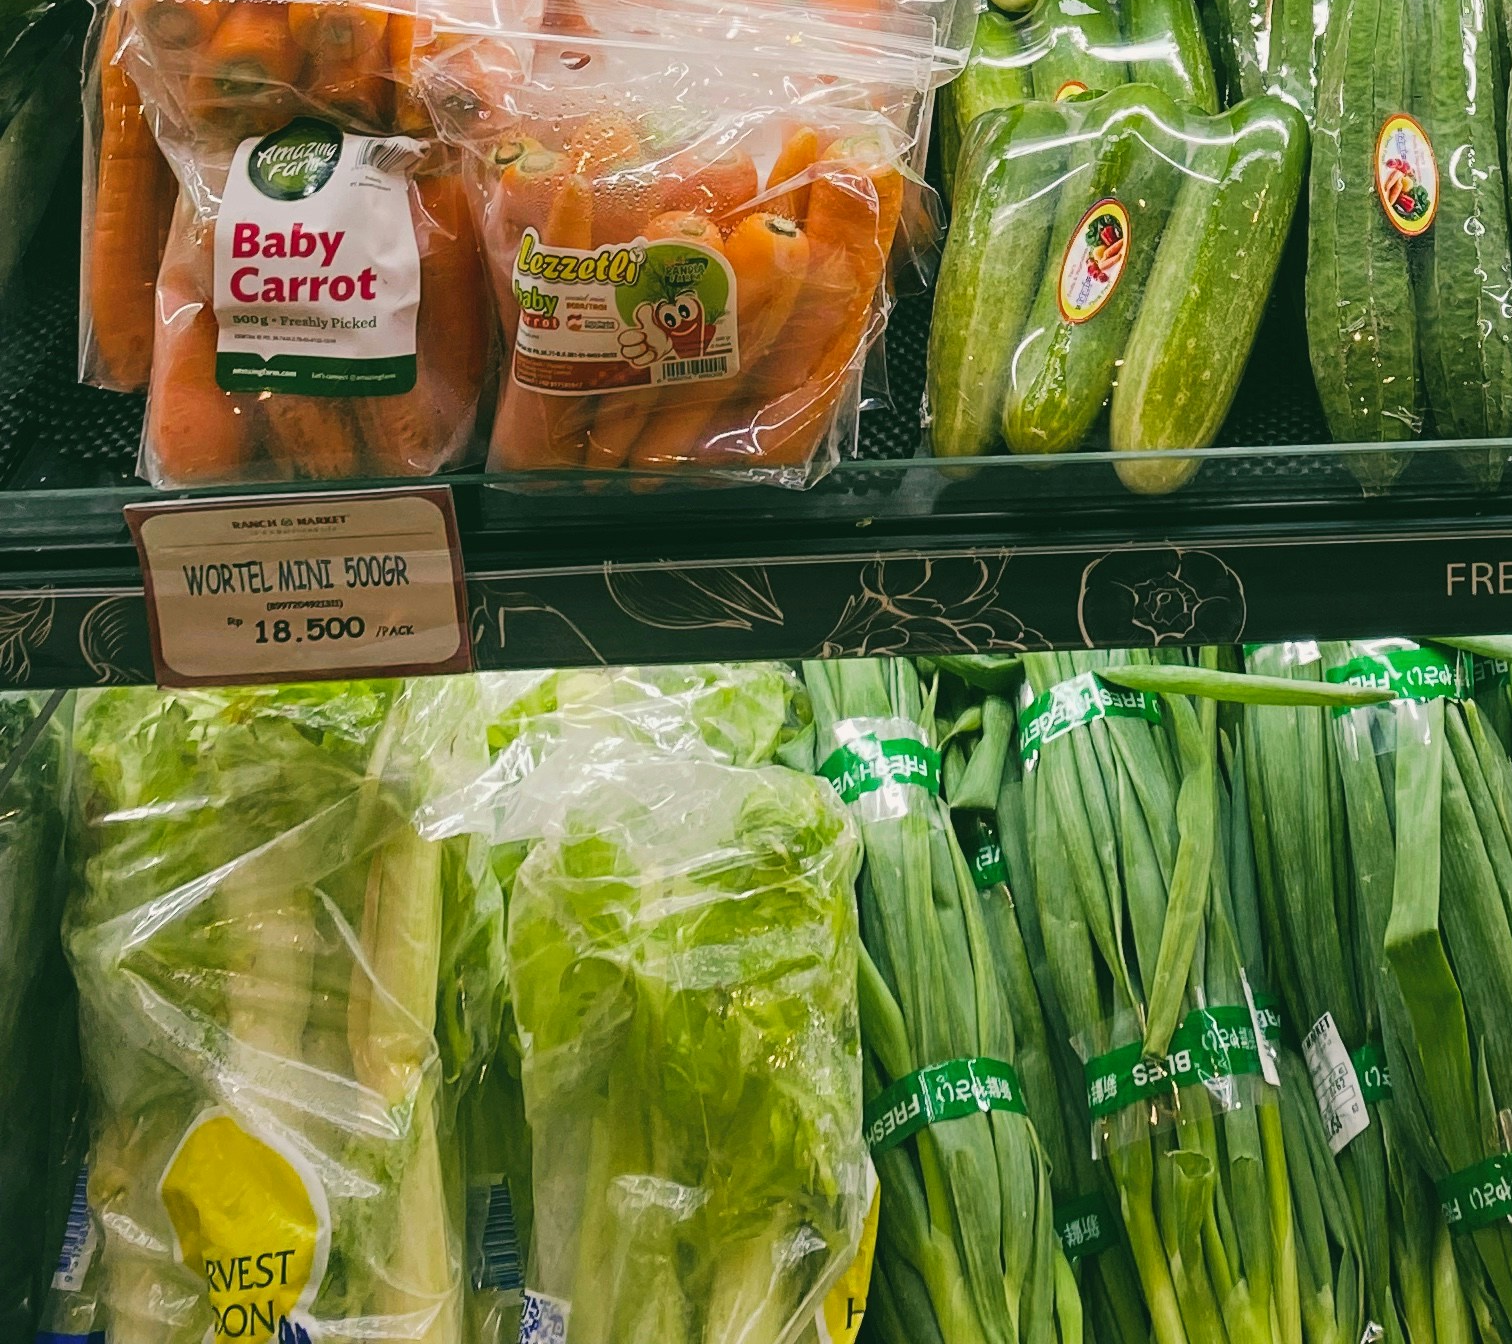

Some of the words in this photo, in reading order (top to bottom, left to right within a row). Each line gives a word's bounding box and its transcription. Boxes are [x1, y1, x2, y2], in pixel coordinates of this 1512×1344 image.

[257, 140, 338, 169] Amazing
[268, 157, 319, 182] Farm
[231, 222, 346, 268] Baby
[517, 233, 641, 284] Lezzetli
[230, 266, 377, 303] Carrot
[233, 314, 269, 327] 500g
[280, 316, 328, 331] Freshly
[331, 316, 377, 329] Picked
[232, 518, 277, 530] RANCH
[297, 515, 347, 526] MARKET
[183, 560, 273, 597] WORTEL
[278, 559, 334, 591] MINI
[345, 554, 410, 588] 500GR
[227, 616, 243, 628] Rp
[255, 616, 365, 644] 18.500
[375, 624, 415, 638] /PACK
[205, 1249, 296, 1291] RVEST
